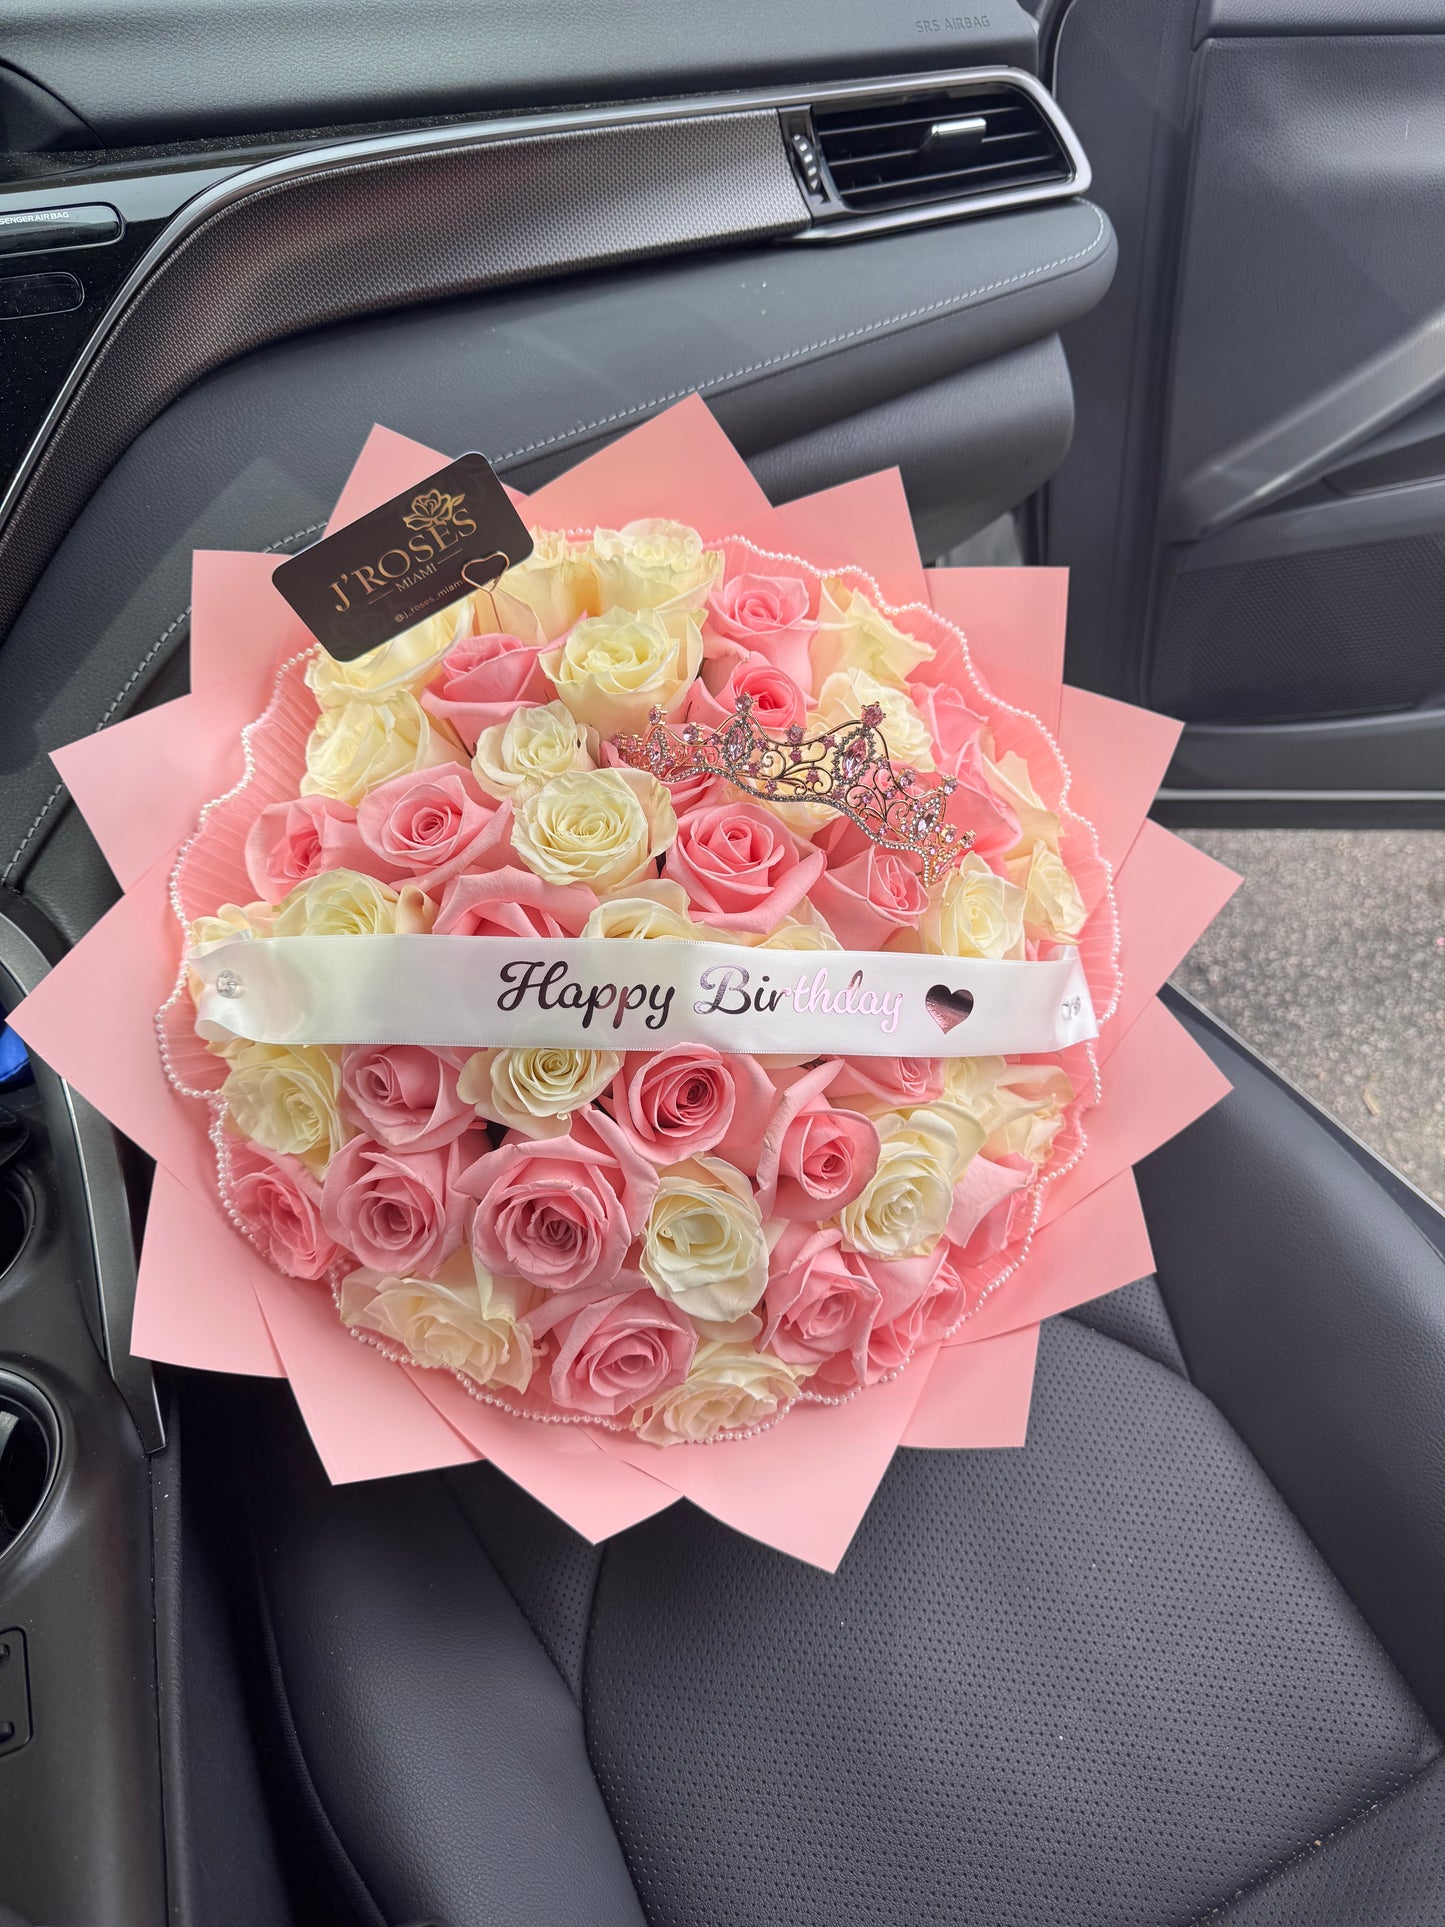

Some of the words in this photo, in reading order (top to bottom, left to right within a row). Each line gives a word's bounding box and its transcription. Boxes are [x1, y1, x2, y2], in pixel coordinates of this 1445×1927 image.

[915, 20, 940, 33] SRS
[944, 15, 991, 31] AIRBAG
[395, 562, 438, 592] MIAMI
[497, 960, 677, 1030] Happy
[694, 963, 904, 1034] Birthday
